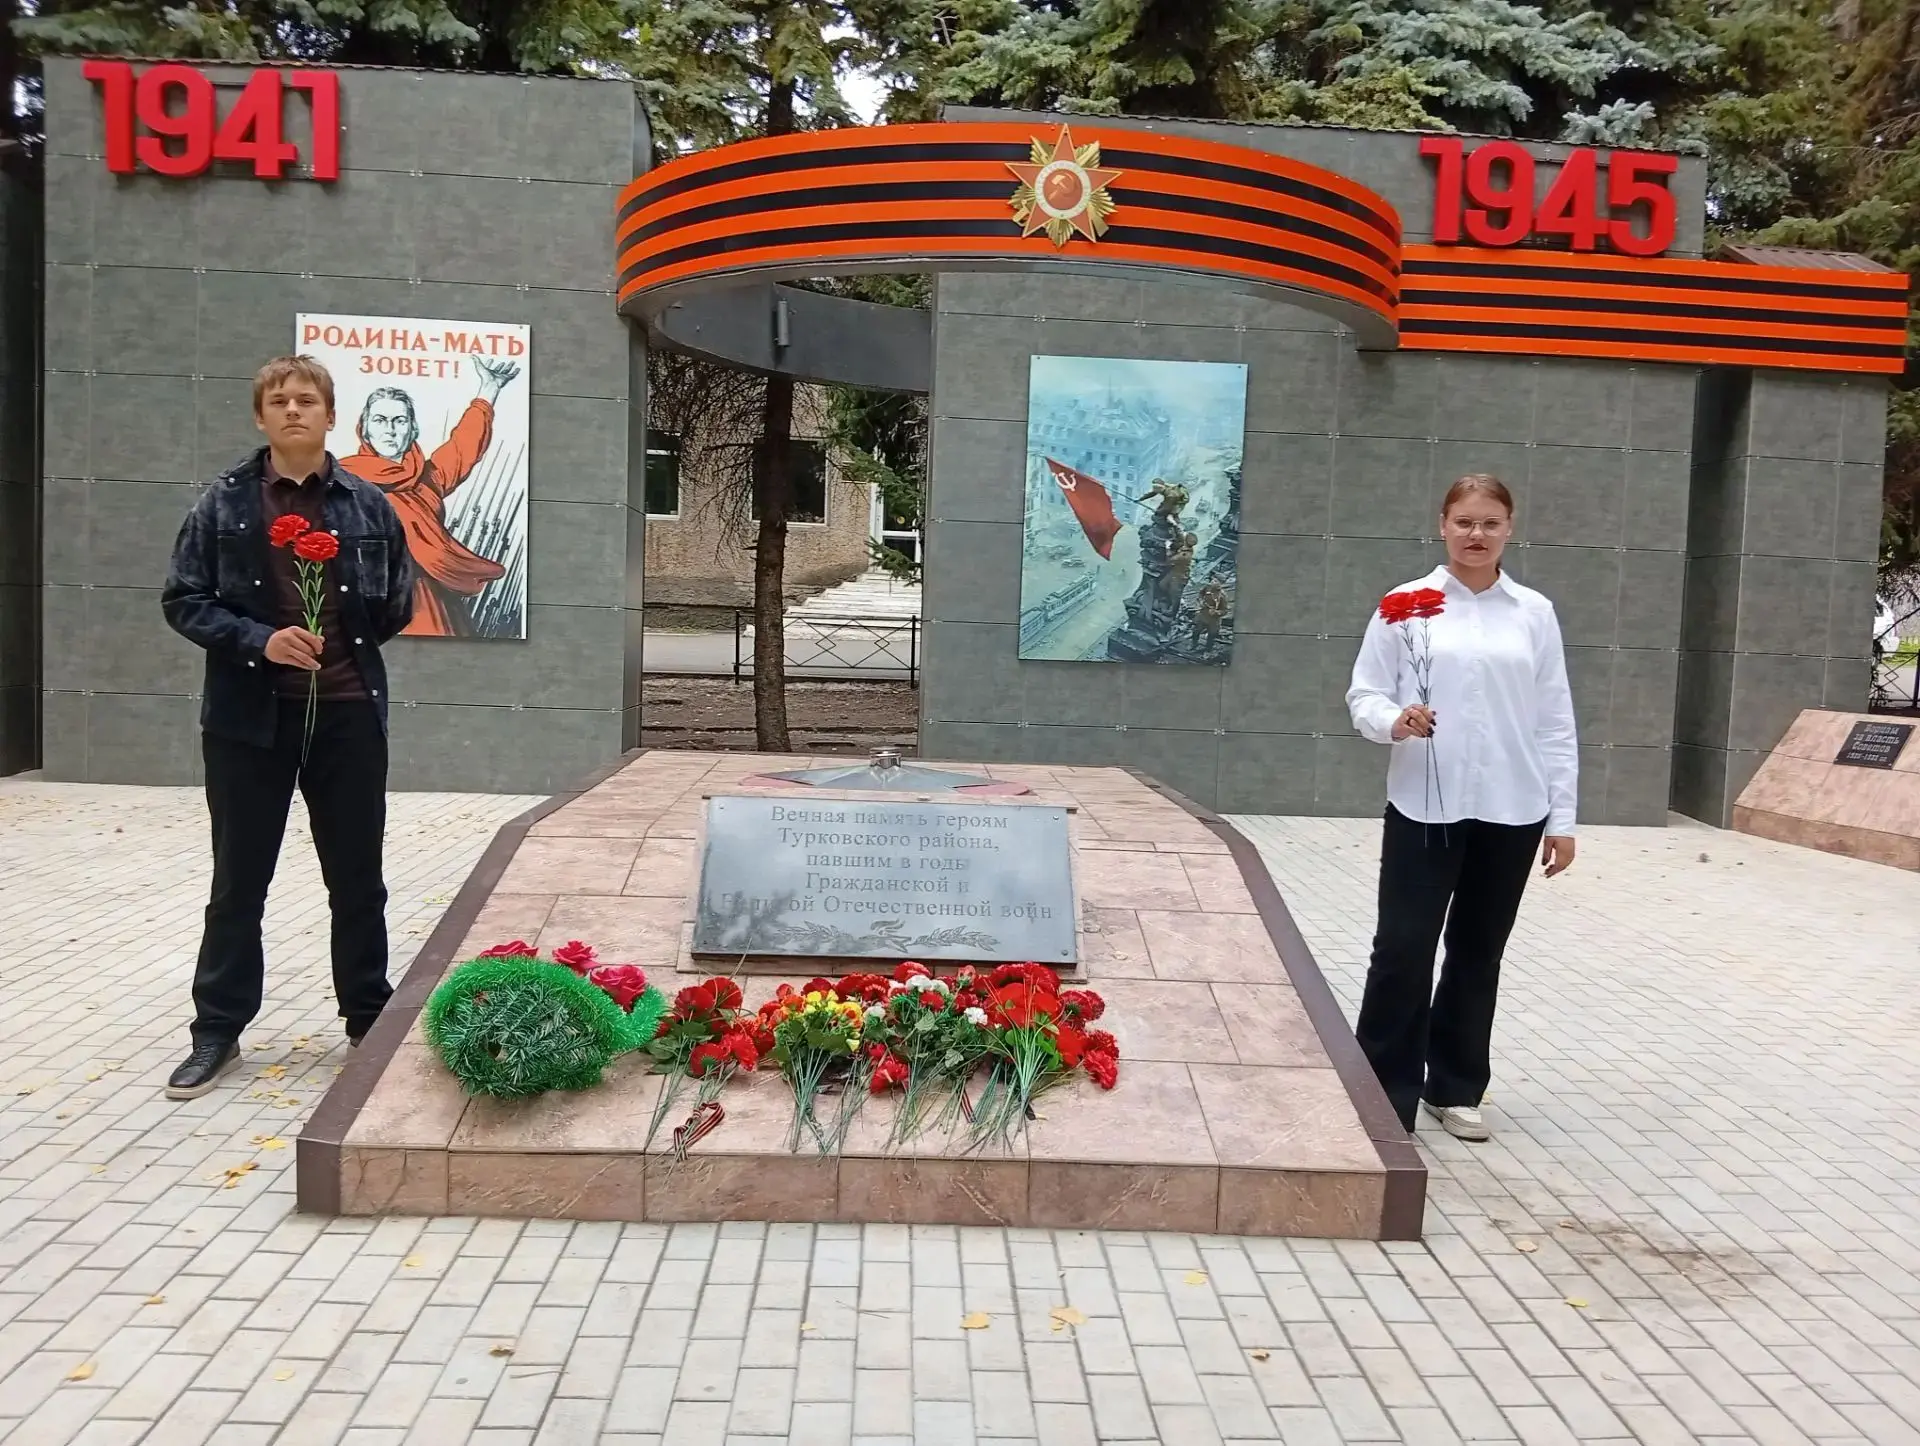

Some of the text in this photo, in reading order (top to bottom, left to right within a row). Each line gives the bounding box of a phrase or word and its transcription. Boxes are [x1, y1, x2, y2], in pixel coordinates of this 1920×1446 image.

[83, 60, 339, 181] 1941
[1420, 137, 1678, 255] 1945
[303, 325, 524, 356] РОДИНА-МАТЬ
[359, 355, 460, 378] ЗОВЕТ!
[771, 806, 1008, 831] Вечная память героям
[778, 827, 1000, 852] Турковского района,
[806, 854, 970, 871] павшим в годы
[805, 872, 969, 894] Гражданской и
[824, 895, 992, 917] Отечественной
[1001, 902, 1052, 919] войн
